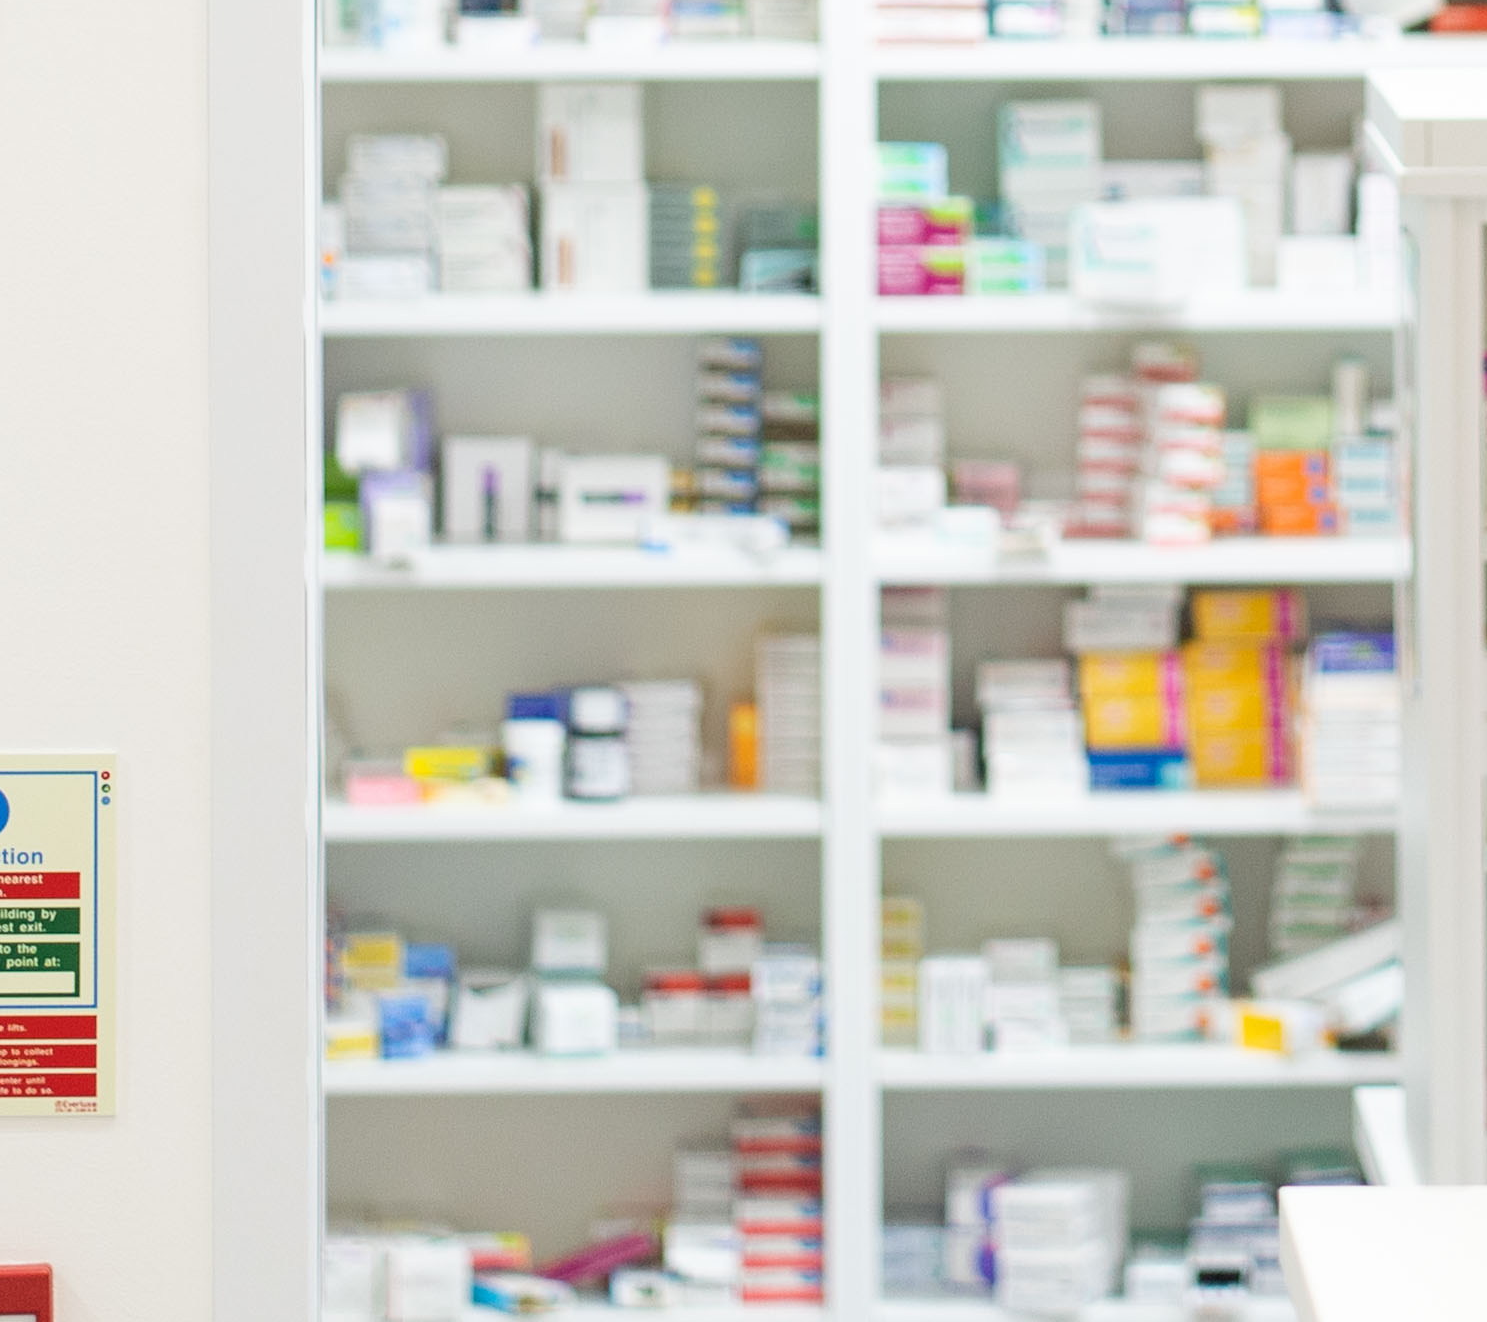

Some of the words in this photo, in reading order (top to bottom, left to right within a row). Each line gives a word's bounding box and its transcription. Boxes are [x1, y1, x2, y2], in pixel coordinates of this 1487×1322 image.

[41, 909, 57, 922] by
[19, 922, 47, 933] exit.
[17, 944, 37, 955] the
[6, 957, 39, 969] point
[44, 957, 61, 968] at:
[11, 1048, 21, 1056] to
[24, 1047, 54, 1056] collect
